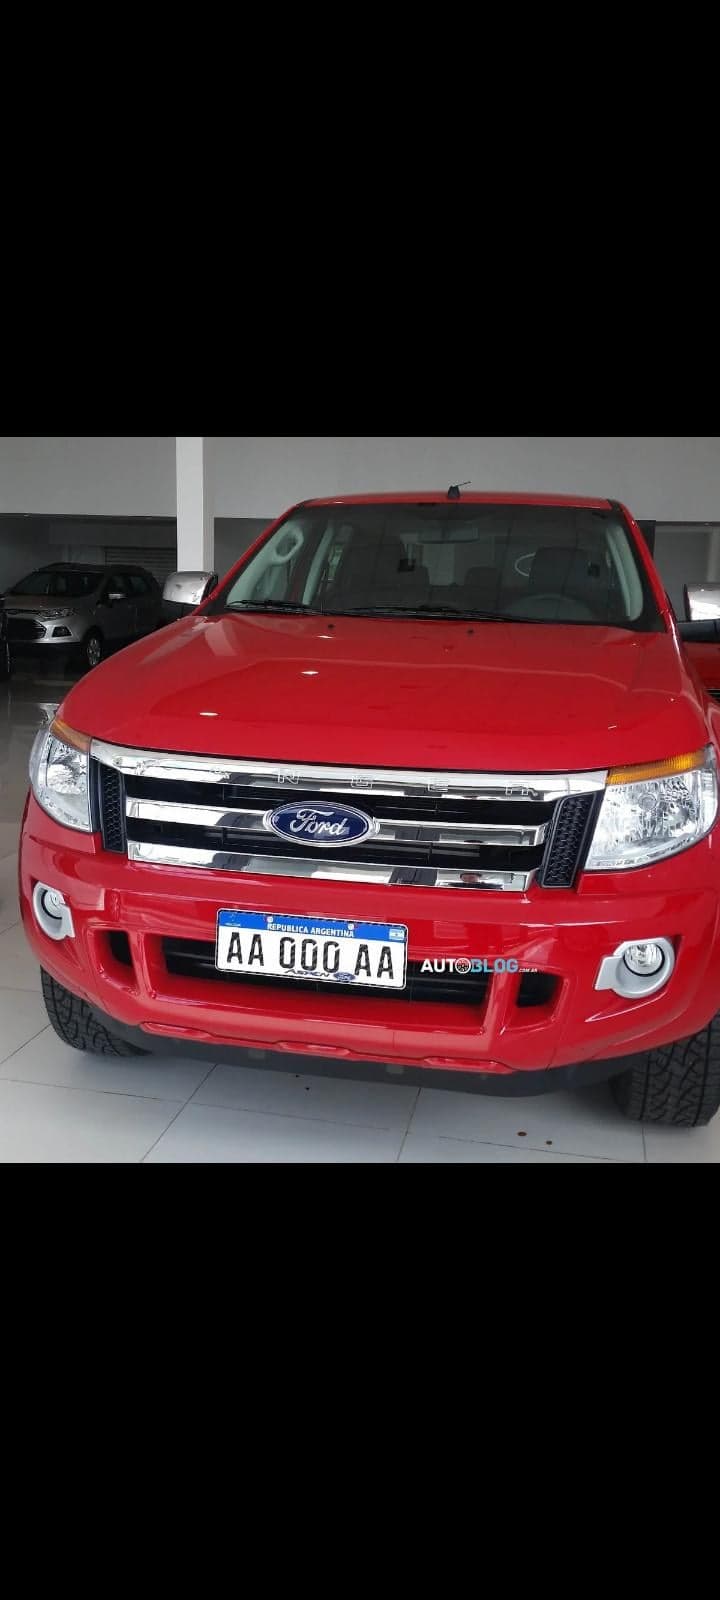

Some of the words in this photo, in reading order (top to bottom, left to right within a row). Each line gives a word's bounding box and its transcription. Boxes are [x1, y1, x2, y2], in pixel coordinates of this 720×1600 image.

[289, 808, 348, 836] Ford
[310, 926, 355, 938] ARGENTINA
[227, 931, 264, 966] AA
[279, 936, 340, 973] 000
[354, 943, 394, 980] AA
